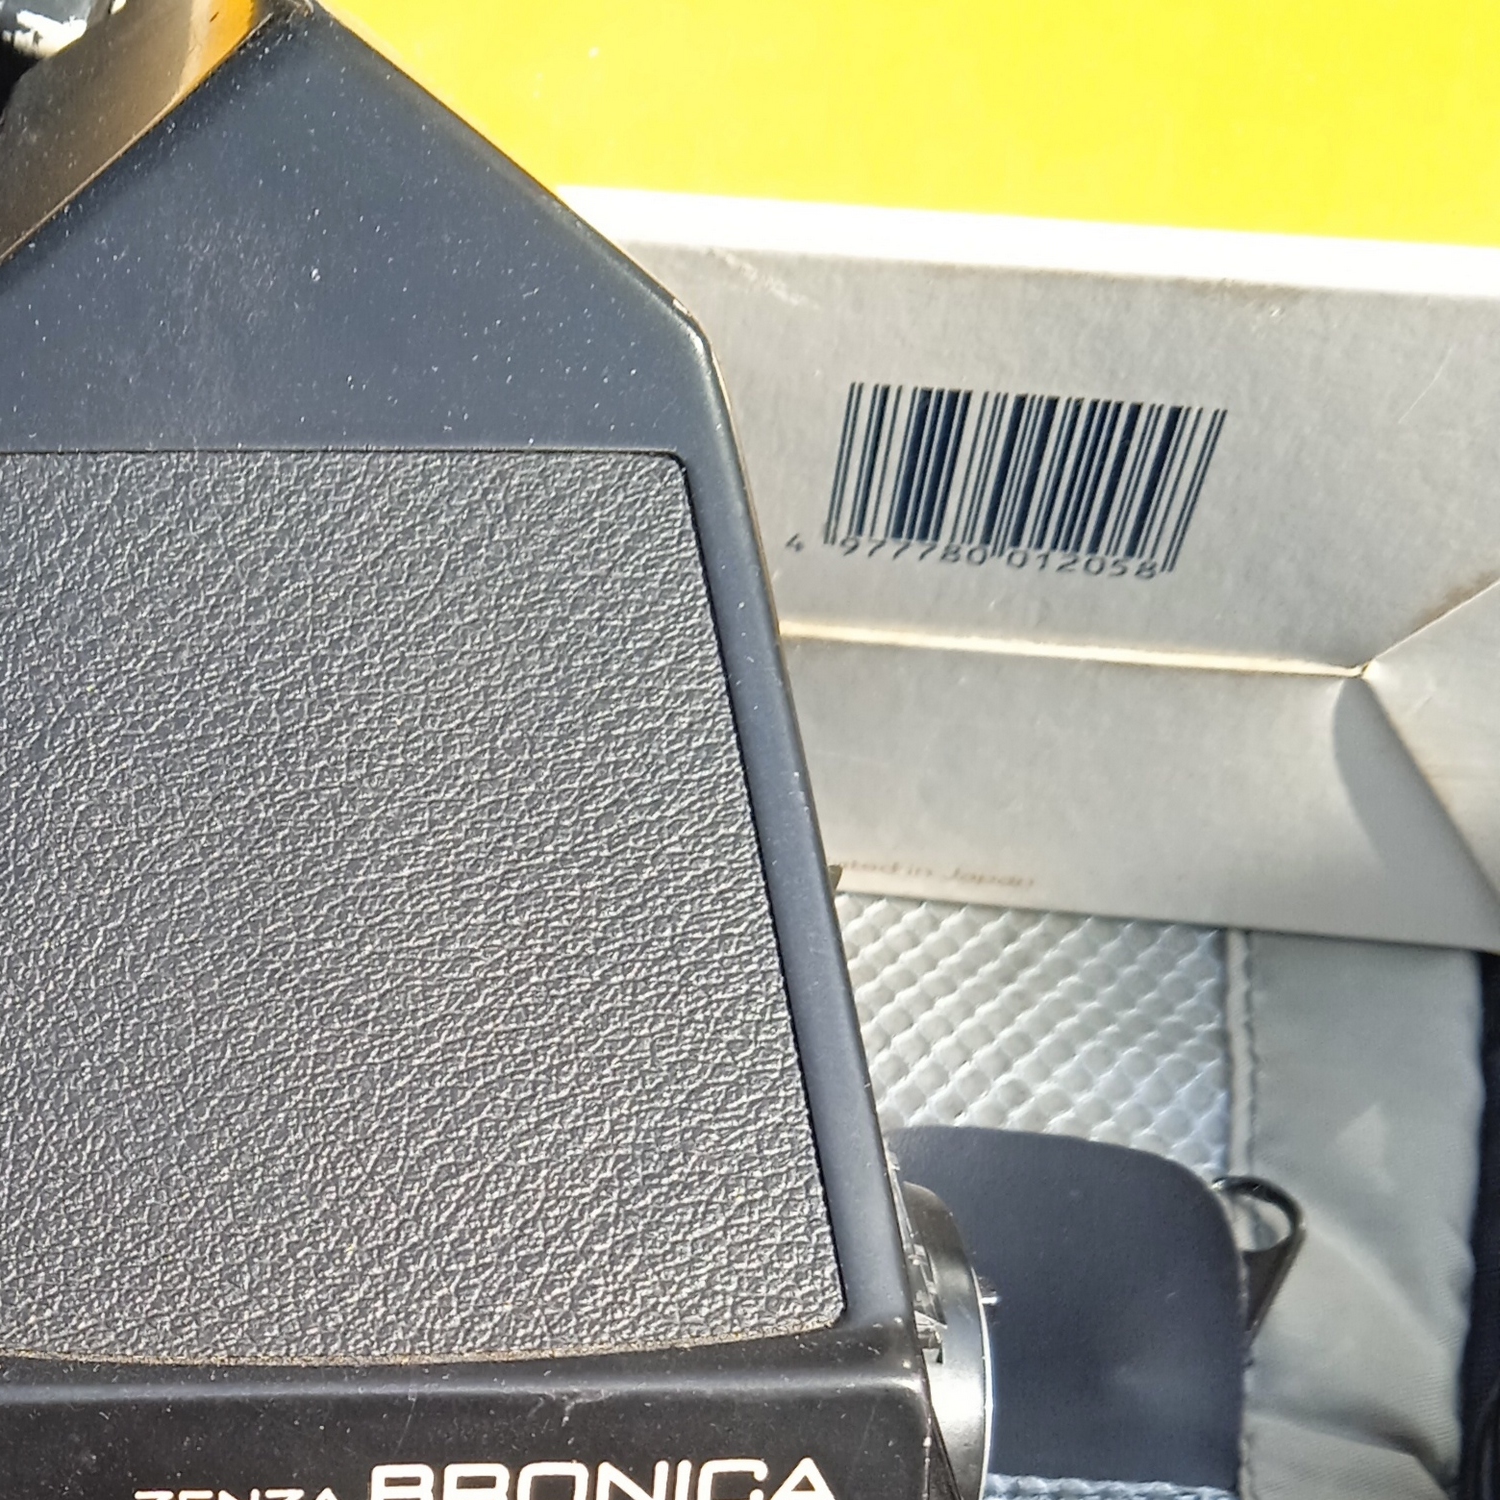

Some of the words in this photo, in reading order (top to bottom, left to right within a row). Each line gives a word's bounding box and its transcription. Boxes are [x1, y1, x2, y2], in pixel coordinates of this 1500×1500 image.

[786, 533, 805, 552] 4
[838, 534, 990, 568] 977780
[1007, 548, 1158, 581] 012058
[942, 865, 1035, 890] Japan
